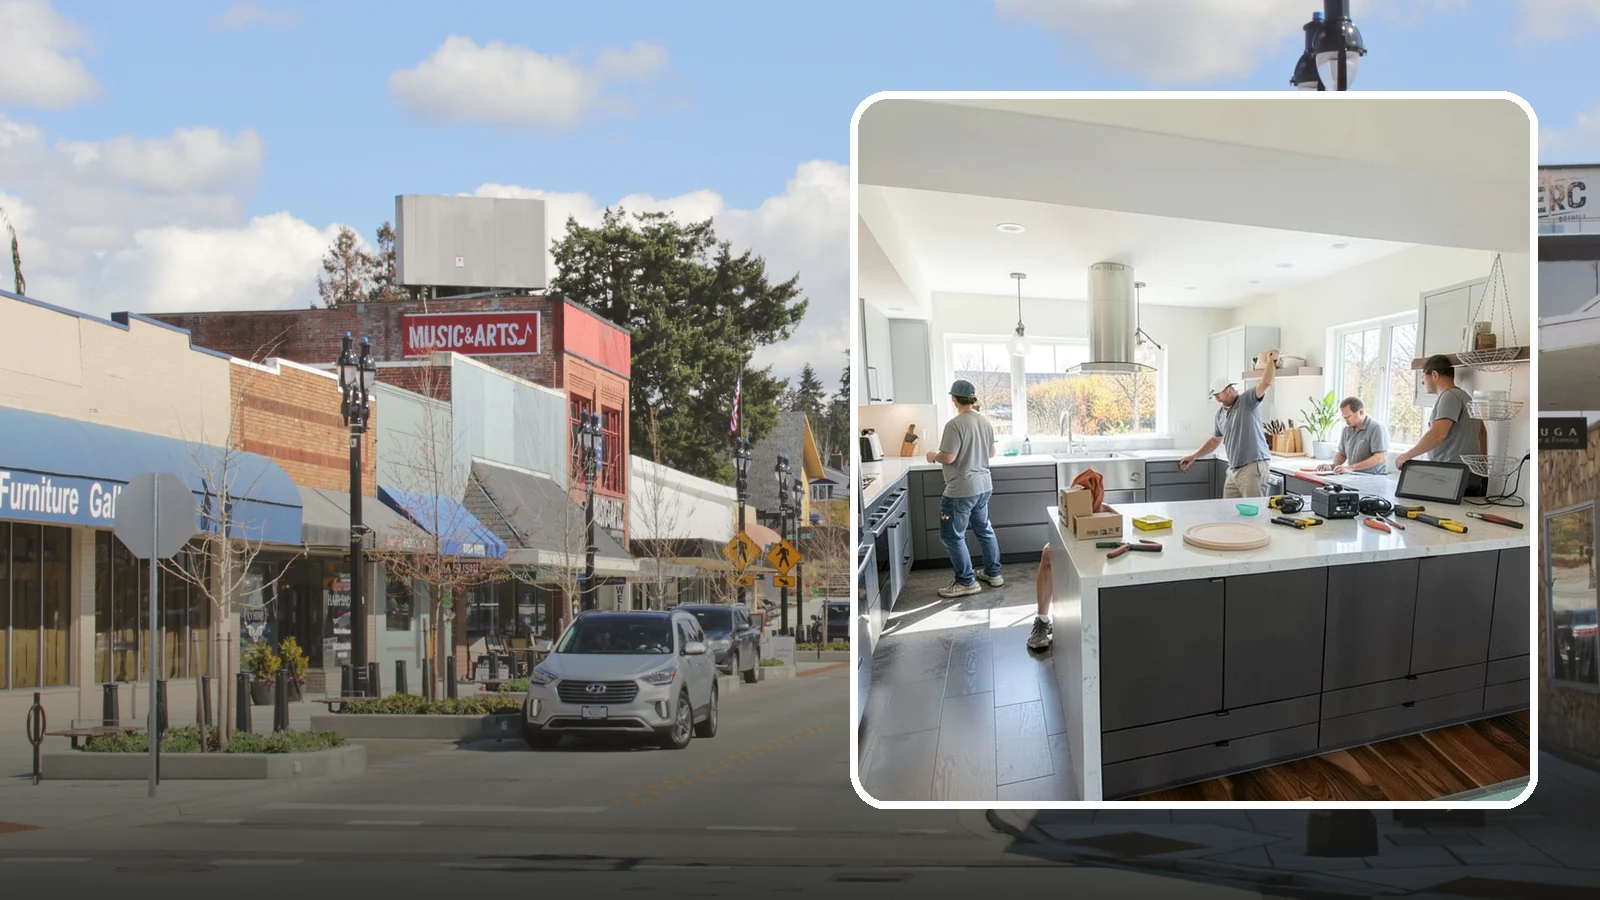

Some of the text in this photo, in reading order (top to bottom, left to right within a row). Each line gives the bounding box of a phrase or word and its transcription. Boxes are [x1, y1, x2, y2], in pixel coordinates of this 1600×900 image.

[0, 471, 122, 519] Furniture Gal
[453, 563, 480, 575] SUSHI
